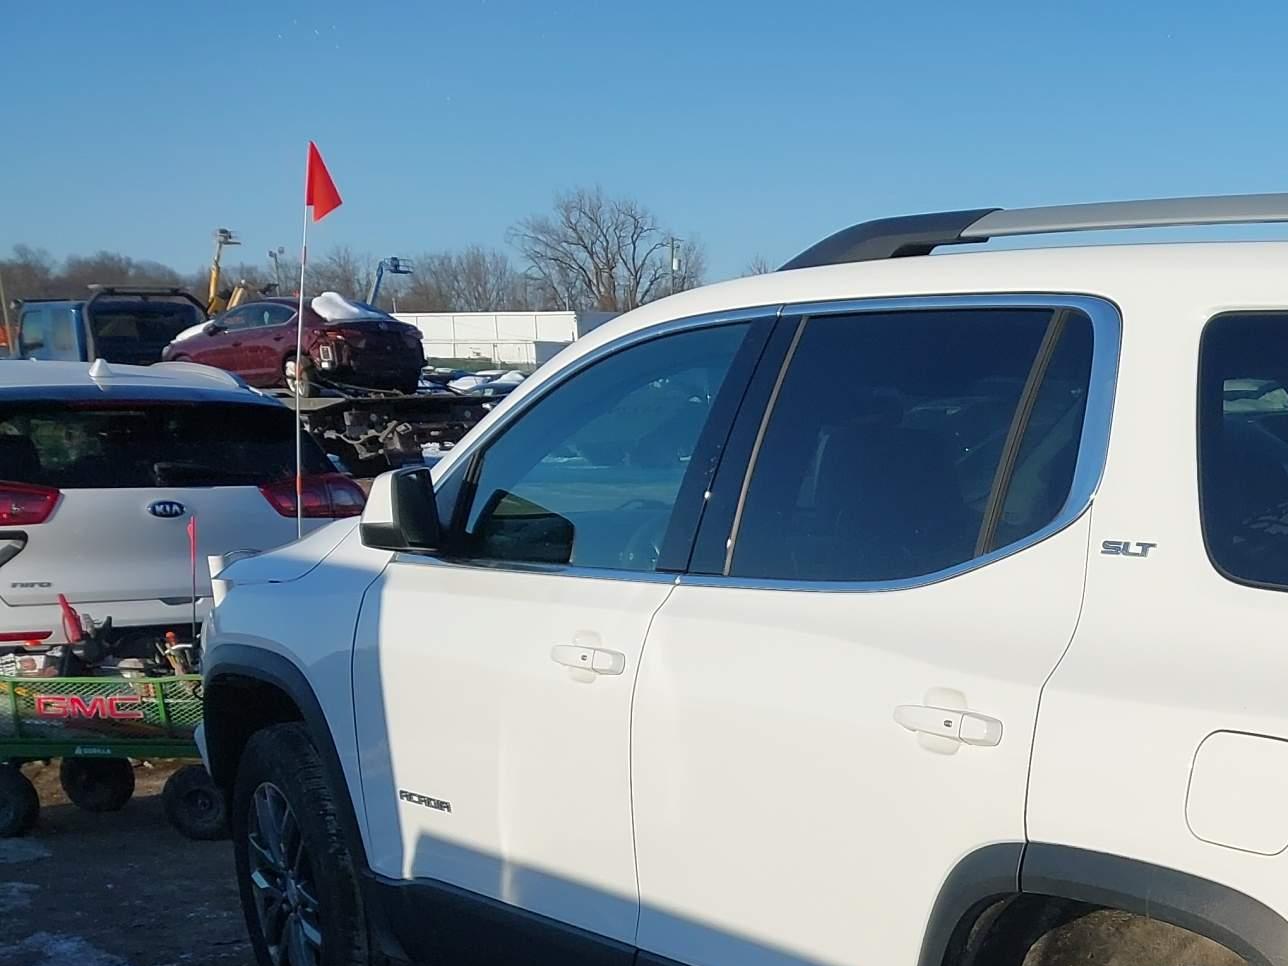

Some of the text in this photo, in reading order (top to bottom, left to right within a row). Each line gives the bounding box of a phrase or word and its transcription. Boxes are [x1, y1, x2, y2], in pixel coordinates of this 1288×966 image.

[154, 504, 182, 515] KIA
[1101, 540, 1157, 557] SLT
[35, 694, 144, 719] GMC
[399, 789, 452, 813] ACADIA
